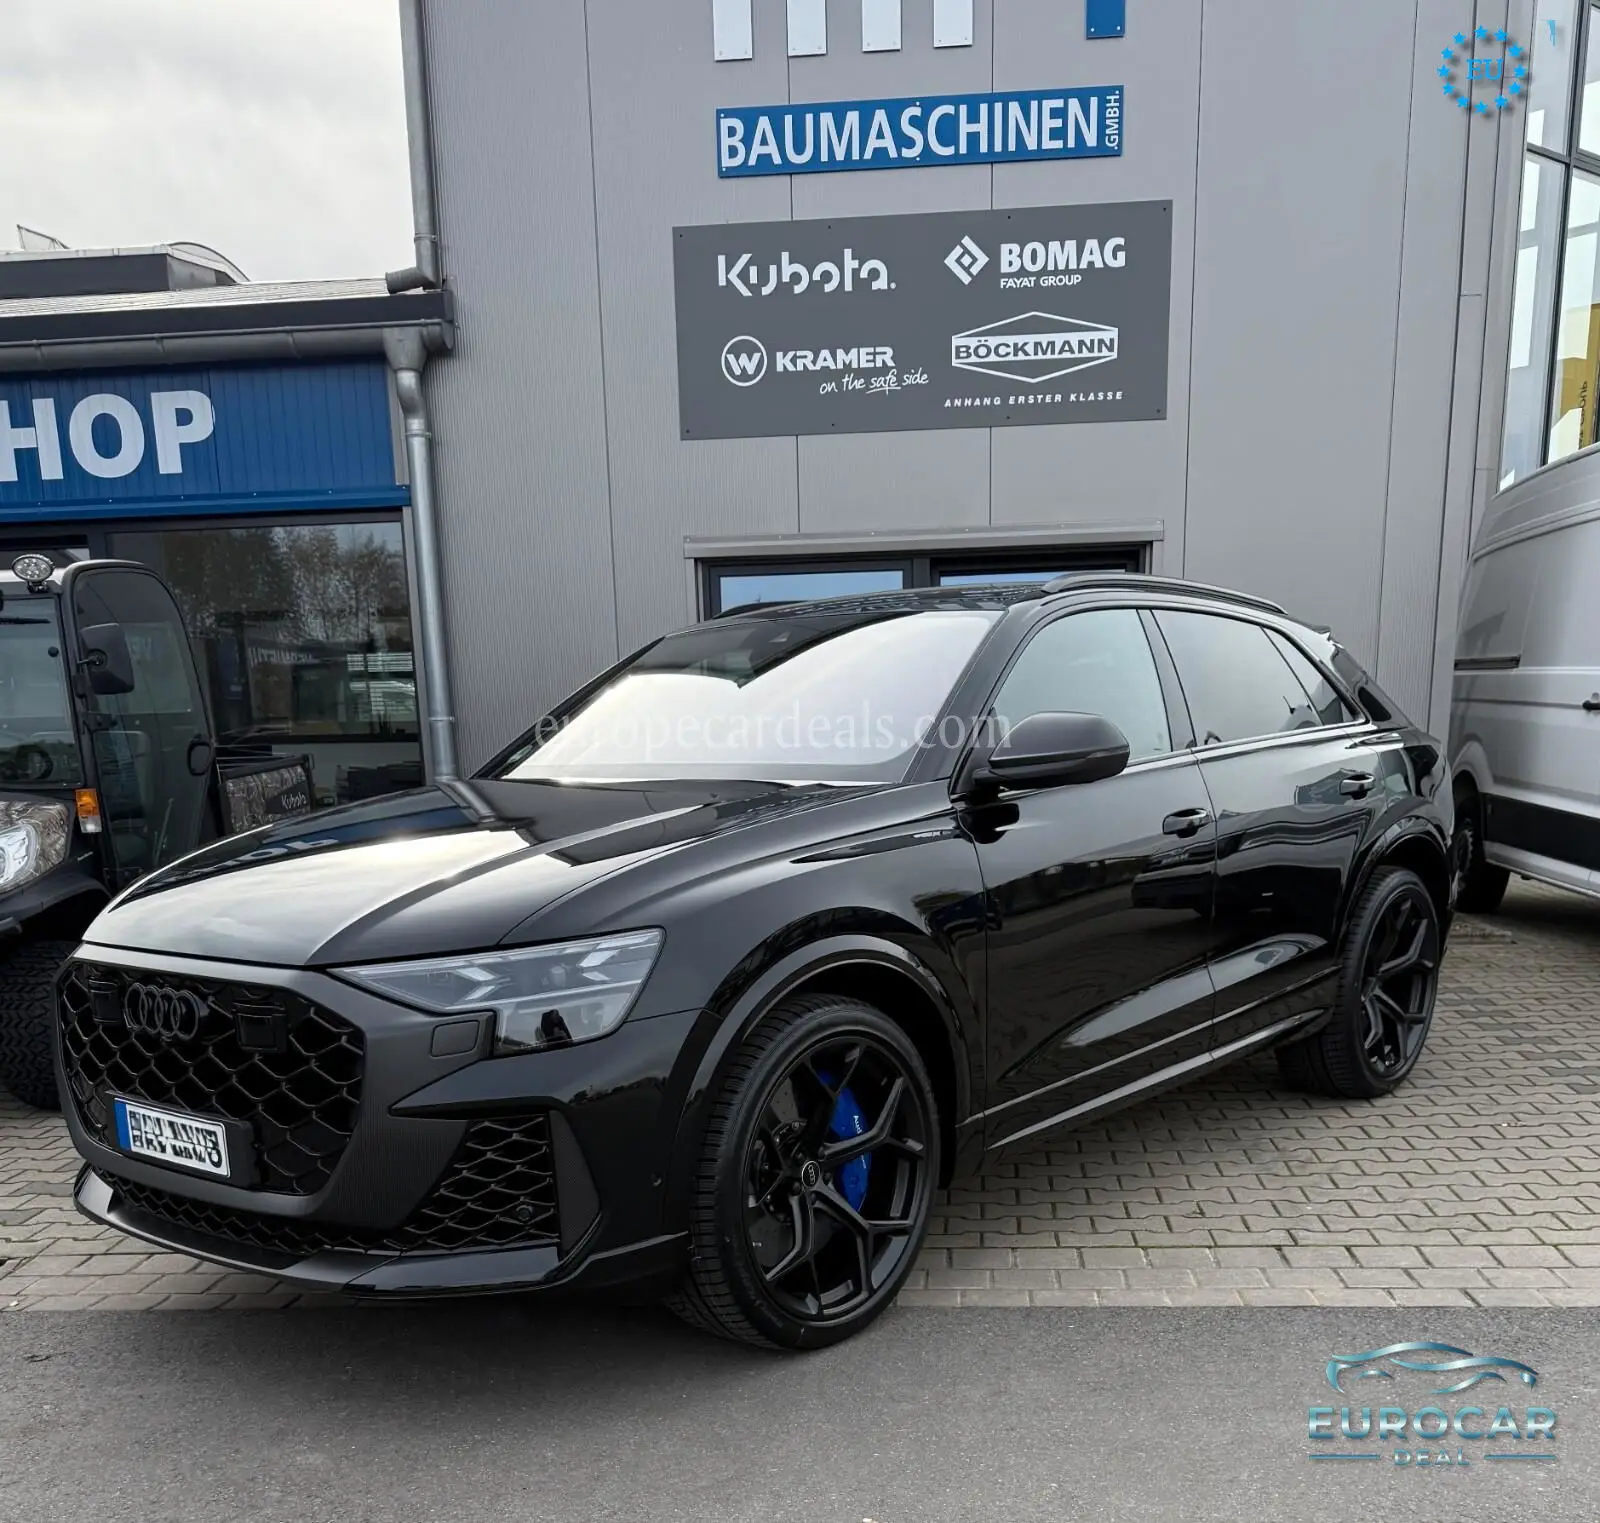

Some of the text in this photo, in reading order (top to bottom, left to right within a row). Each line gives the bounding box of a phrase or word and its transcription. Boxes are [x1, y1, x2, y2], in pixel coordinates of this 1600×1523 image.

[720, 96, 1098, 169] BAUMASCHINEN
[1000, 237, 1126, 273] BOMAG
[1000, 274, 1082, 289] FAYAT GROUP
[776, 346, 896, 372] KRAMER
[954, 337, 1116, 361] BÖCKMANN
[819, 367, 929, 395] on the safe side
[944, 391, 1124, 408] ANHANG ERSTER KLASSE
[0, 390, 216, 482] HOP
